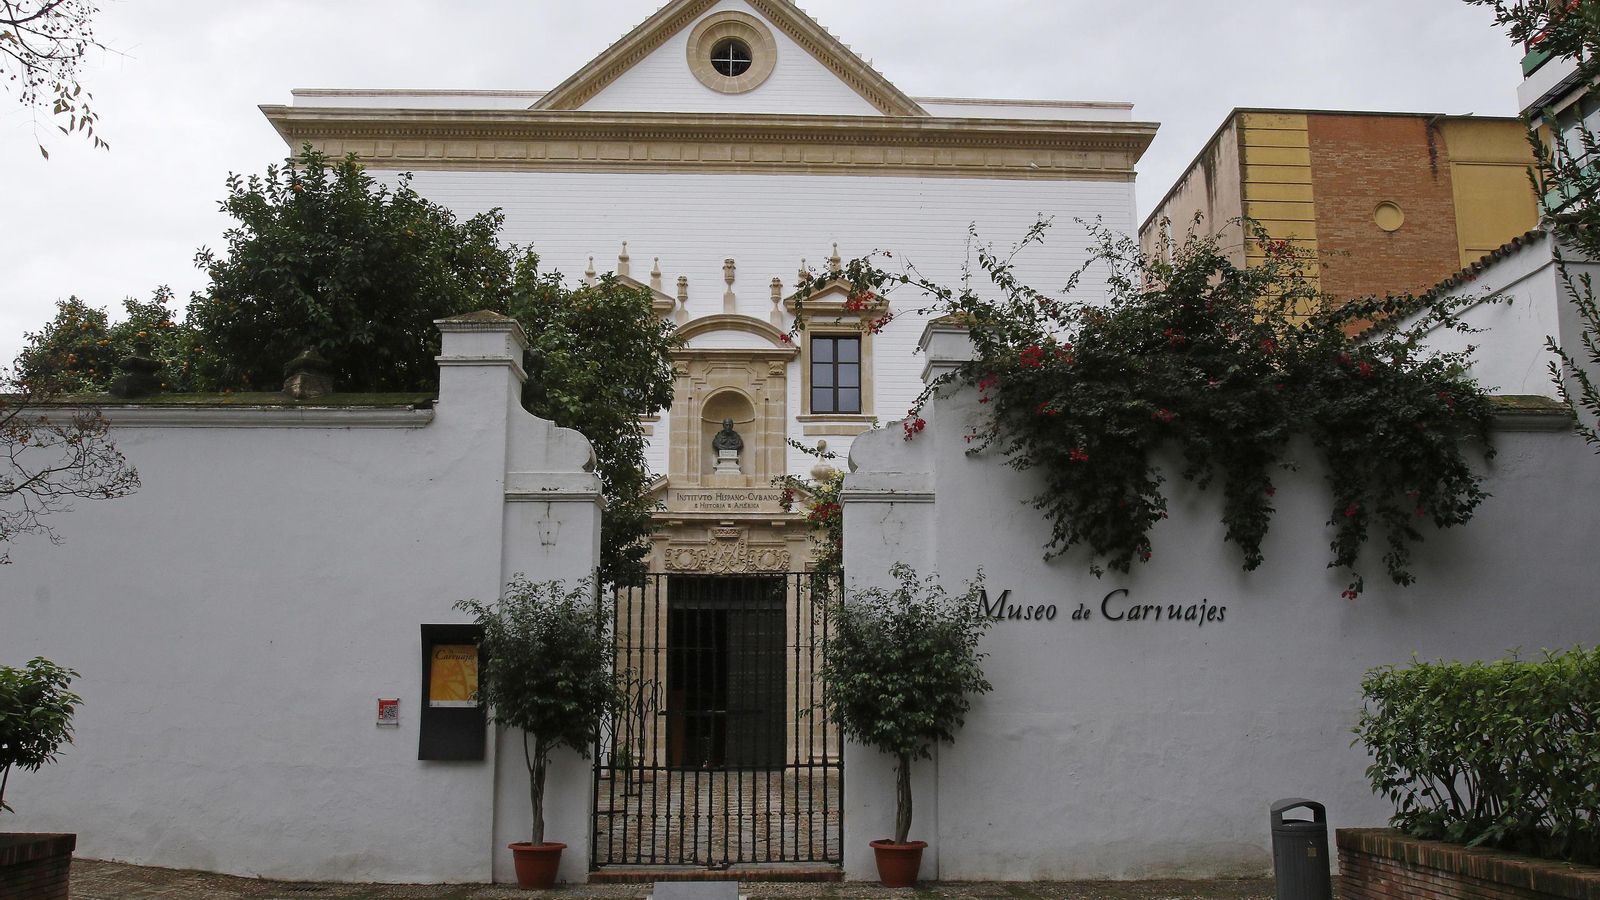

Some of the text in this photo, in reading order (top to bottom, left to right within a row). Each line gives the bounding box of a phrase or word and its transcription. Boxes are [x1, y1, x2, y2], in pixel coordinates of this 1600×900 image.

[974, 588, 1227, 627] Museo de Carruajes
